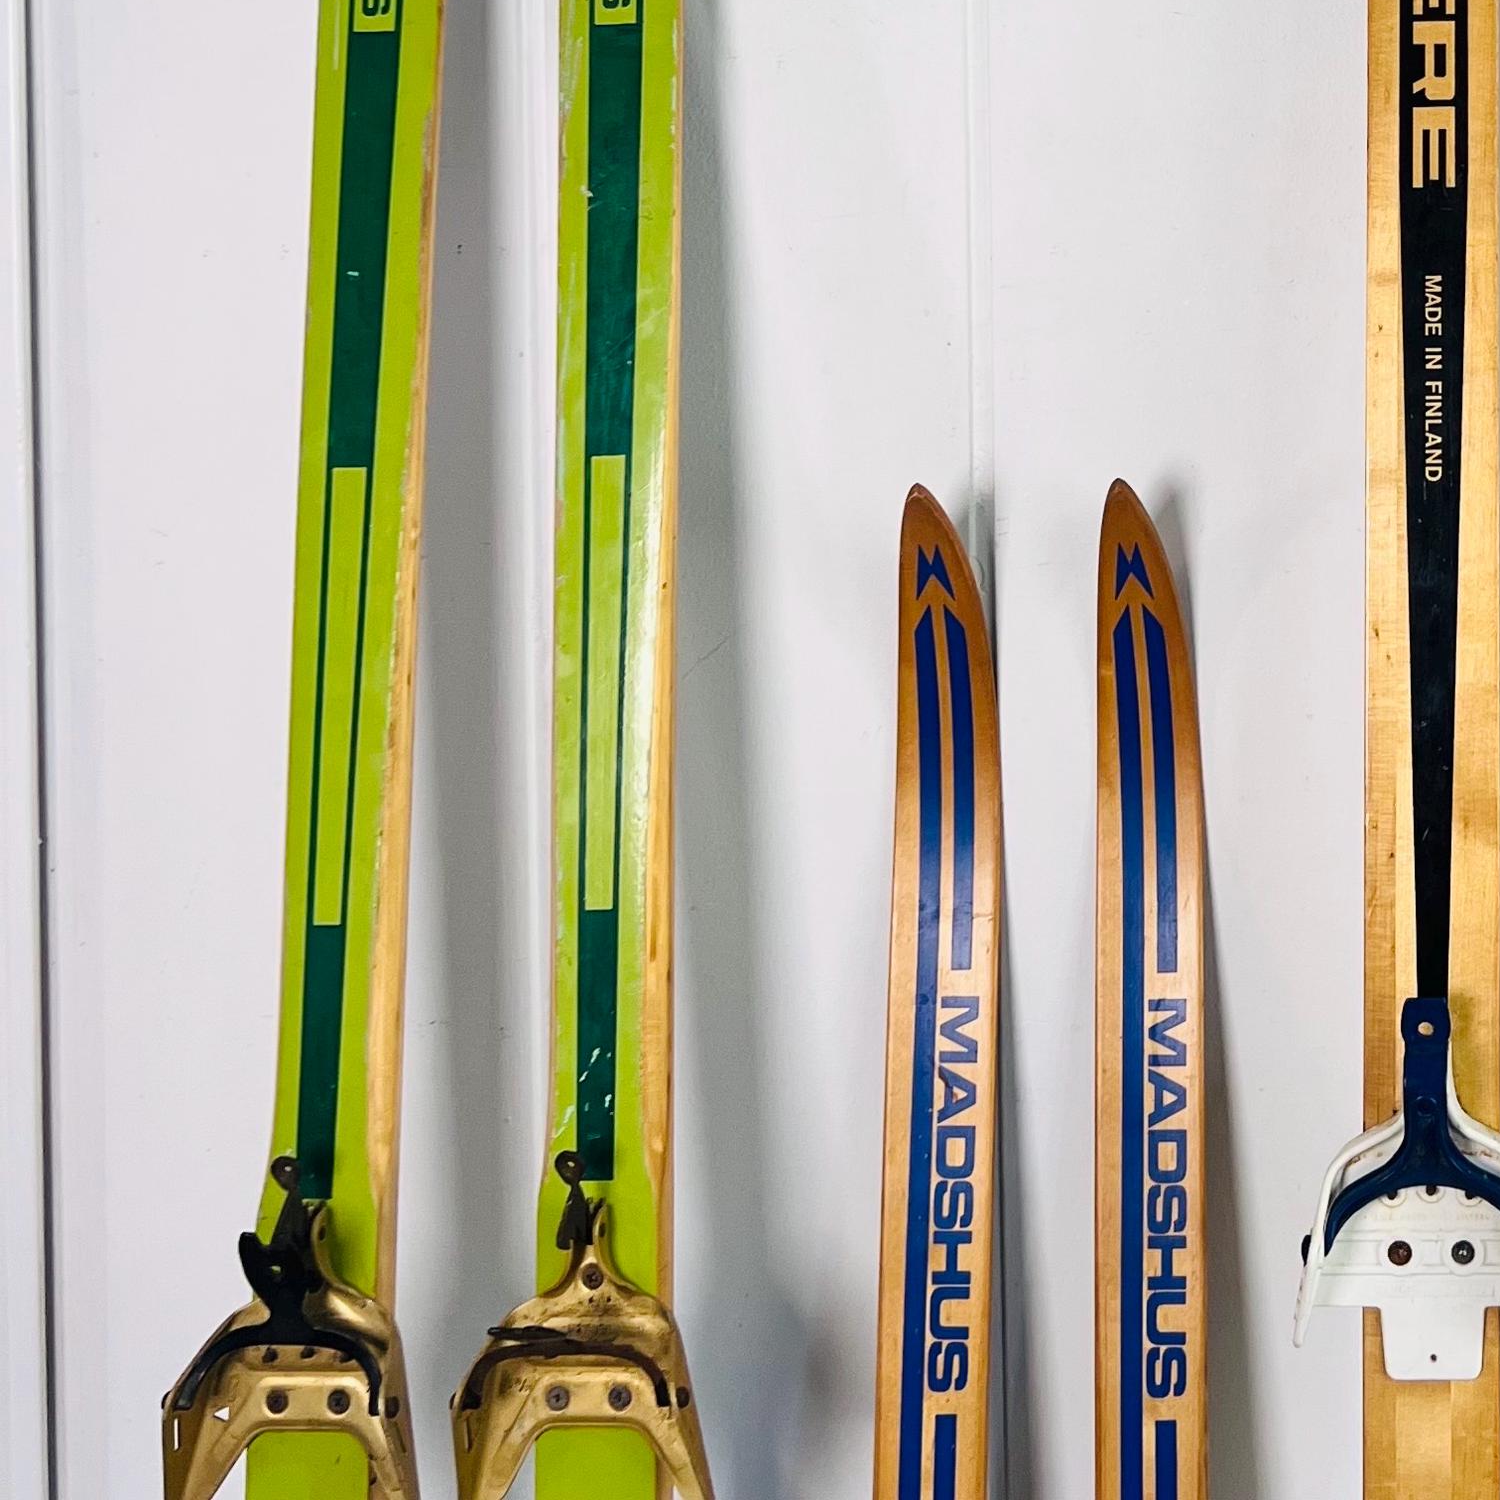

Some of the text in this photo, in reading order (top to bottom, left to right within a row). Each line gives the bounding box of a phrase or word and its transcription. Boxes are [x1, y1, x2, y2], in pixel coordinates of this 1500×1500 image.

[1425, 275, 1443, 482] MADE IN FINLAND
[927, 995, 980, 1393] MADSHUS
[1146, 998, 1188, 1398] MADSHUS
